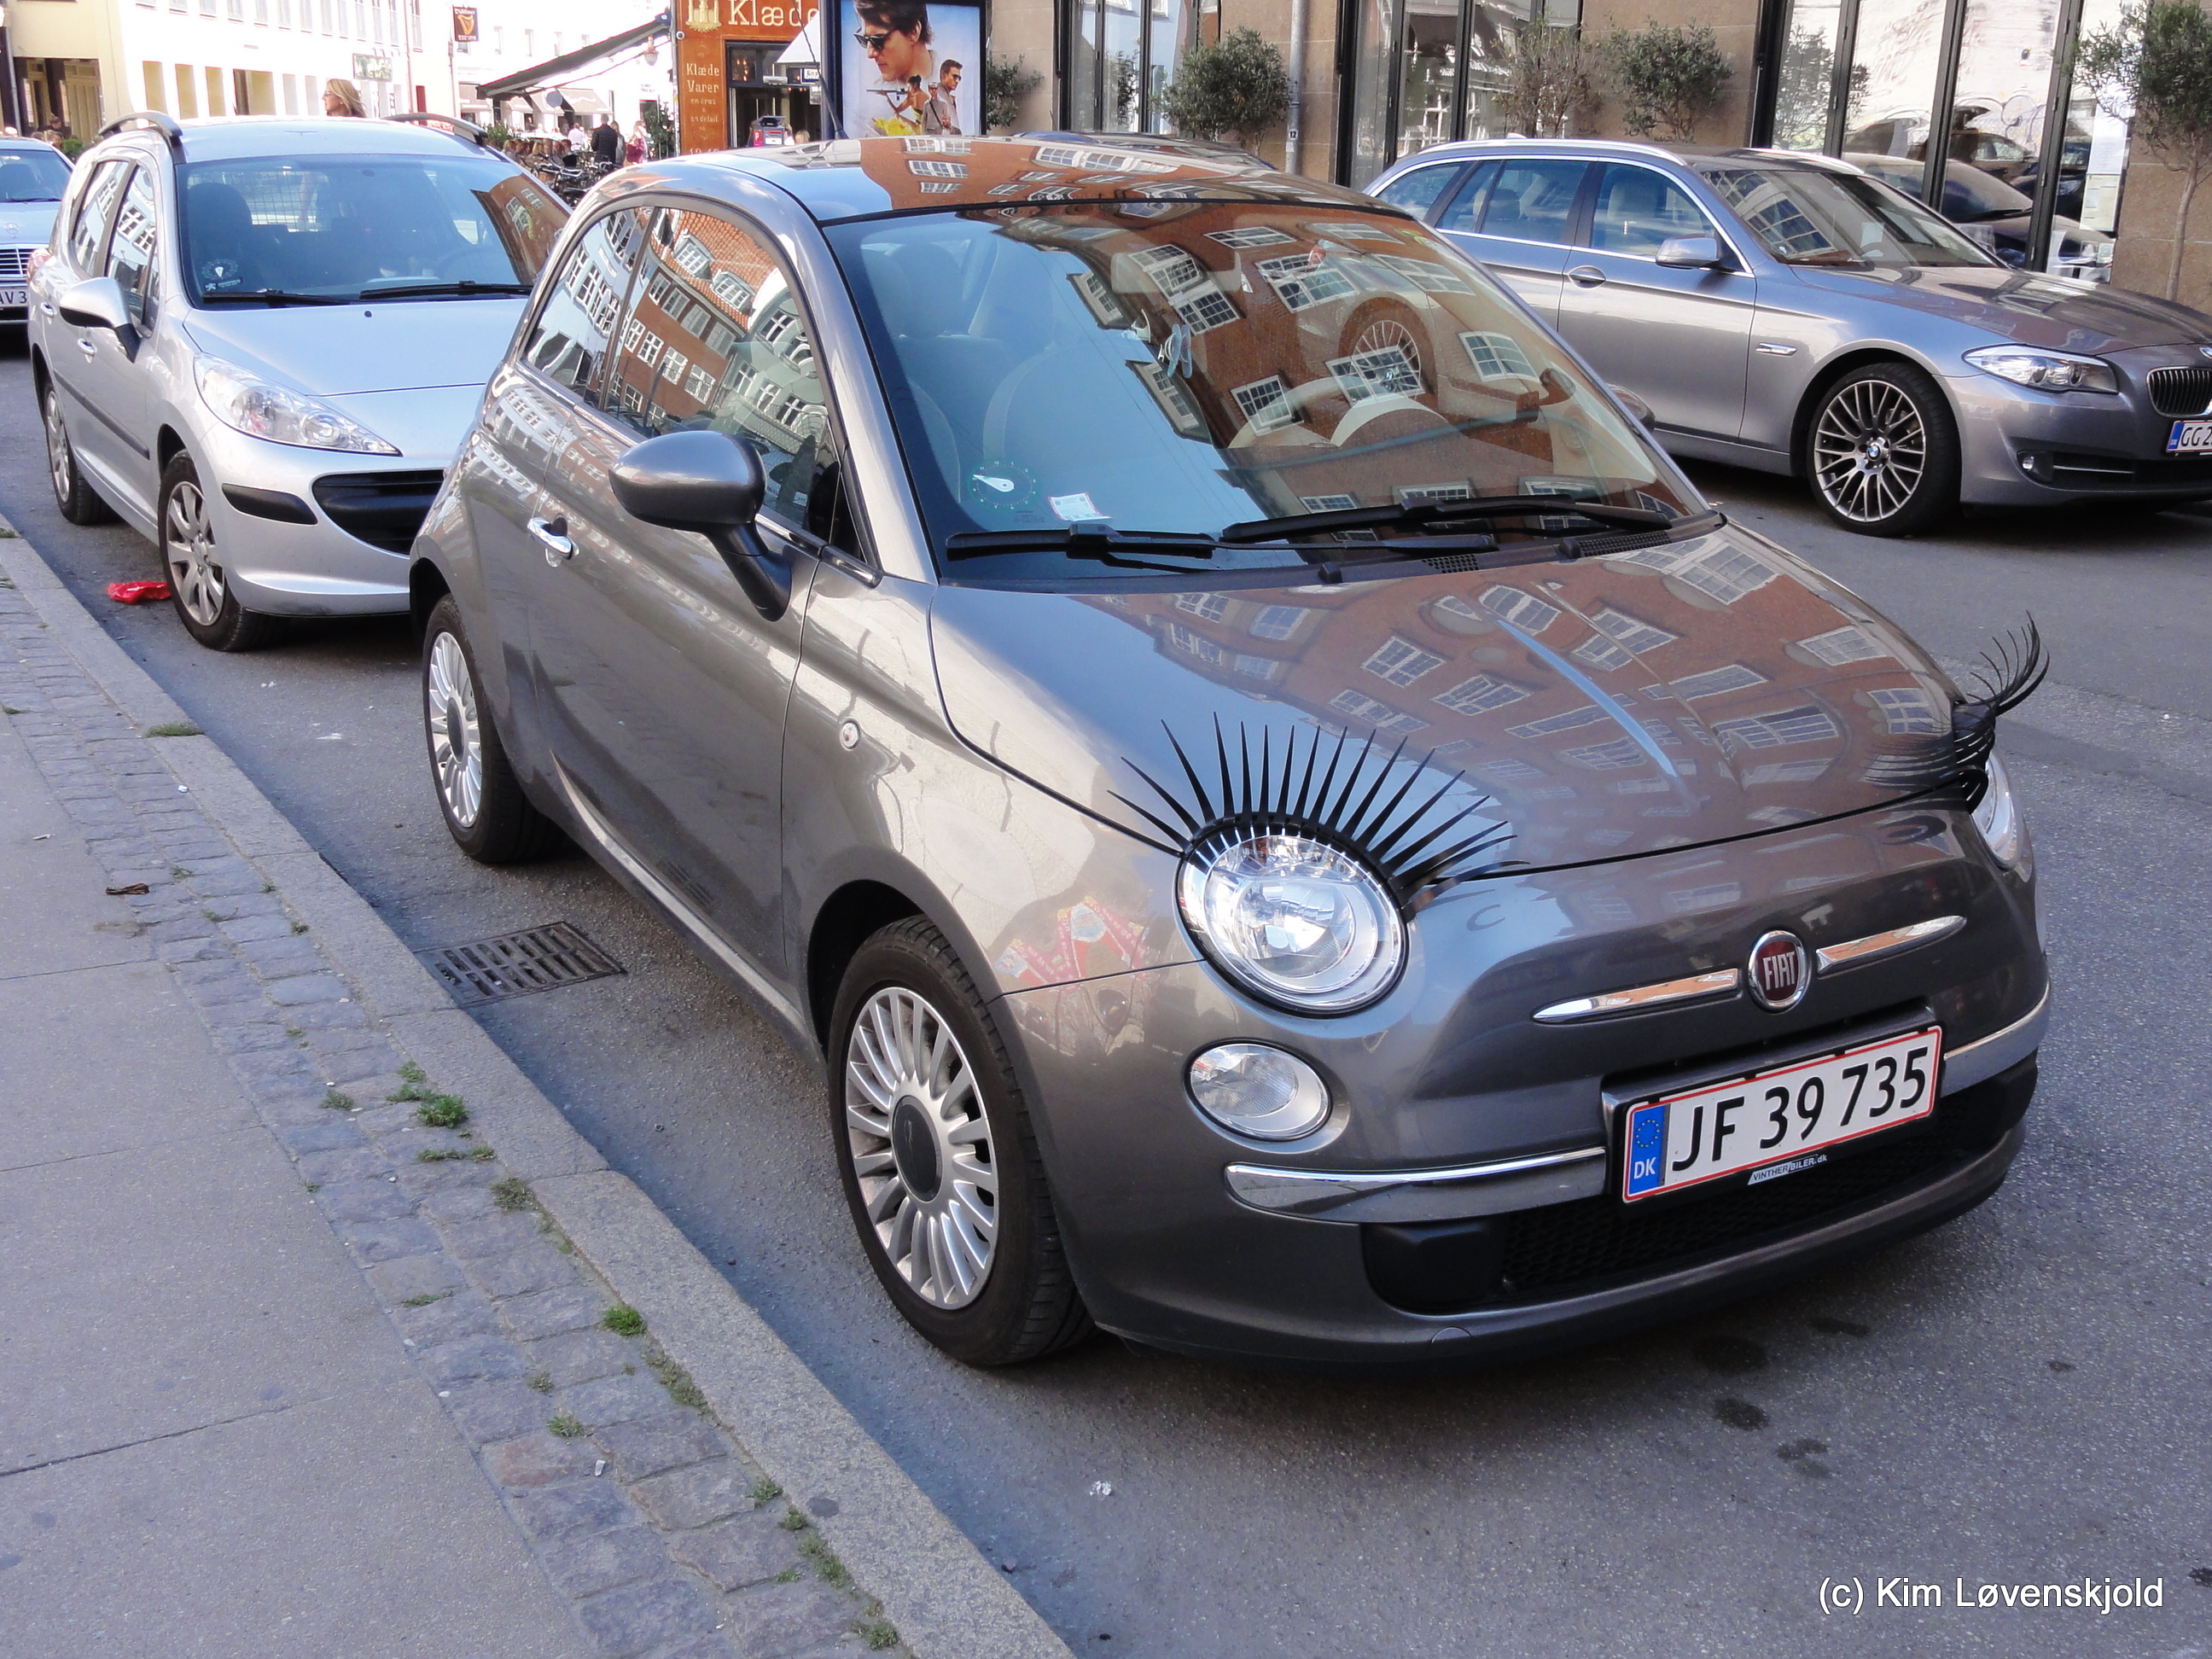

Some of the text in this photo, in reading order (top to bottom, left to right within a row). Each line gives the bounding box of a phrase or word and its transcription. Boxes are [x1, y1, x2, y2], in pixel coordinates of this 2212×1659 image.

[686, 63, 719, 77] Klæde
[687, 80, 719, 93] Varer
[2180, 426, 2212, 446] GG 2
[1762, 951, 1795, 991] FIAT
[1672, 1046, 1930, 1172] JF 39 735
[1633, 1156, 1656, 1179] DK
